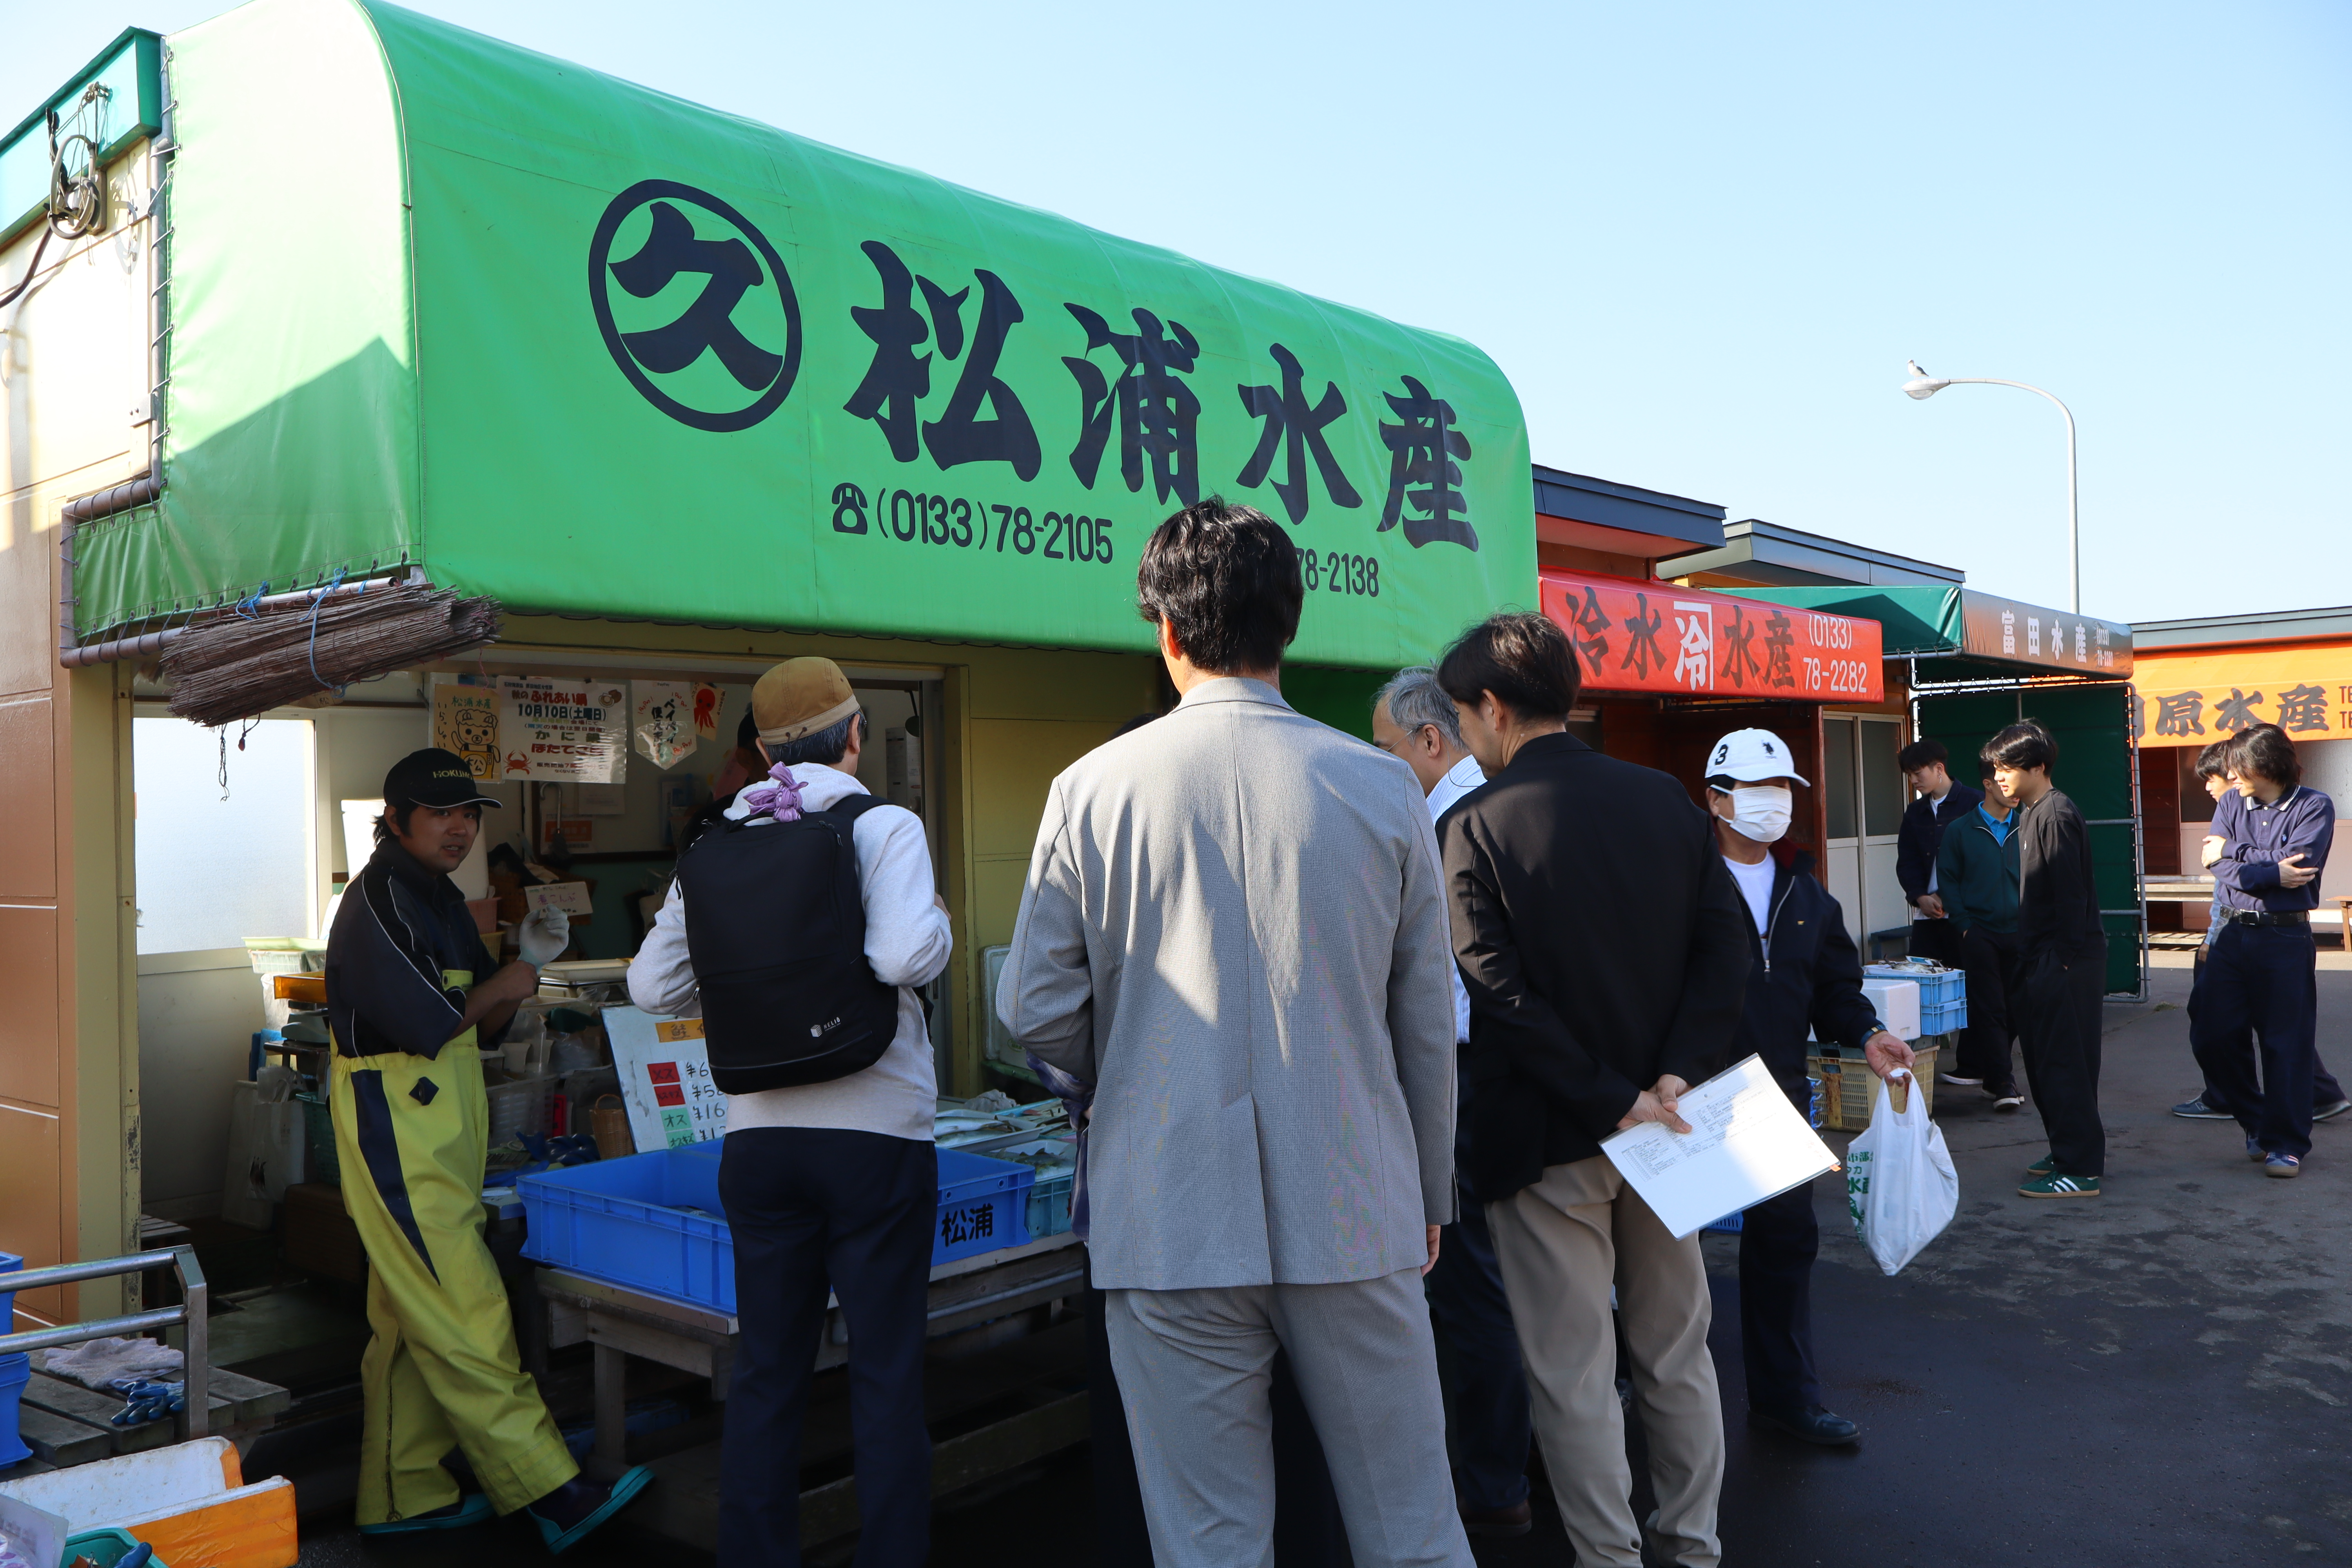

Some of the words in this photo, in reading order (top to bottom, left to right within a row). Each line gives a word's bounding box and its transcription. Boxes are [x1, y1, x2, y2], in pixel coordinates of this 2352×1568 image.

[843, 240, 1479, 553] 松浦水産
[1809, 614, 1852, 650] (0133)
[2001, 609, 2087, 663] 富田水産
[2096, 627, 2109, 646] (0133)
[2097, 649, 2113, 667] 78-2281
[1803, 657, 1867, 693] 78-2282
[451, 695, 492, 709] 松浦水産
[1715, 744, 1728, 766] 3
[664, 1113, 687, 1127] オス
[942, 1203, 993, 1247] 松浦
